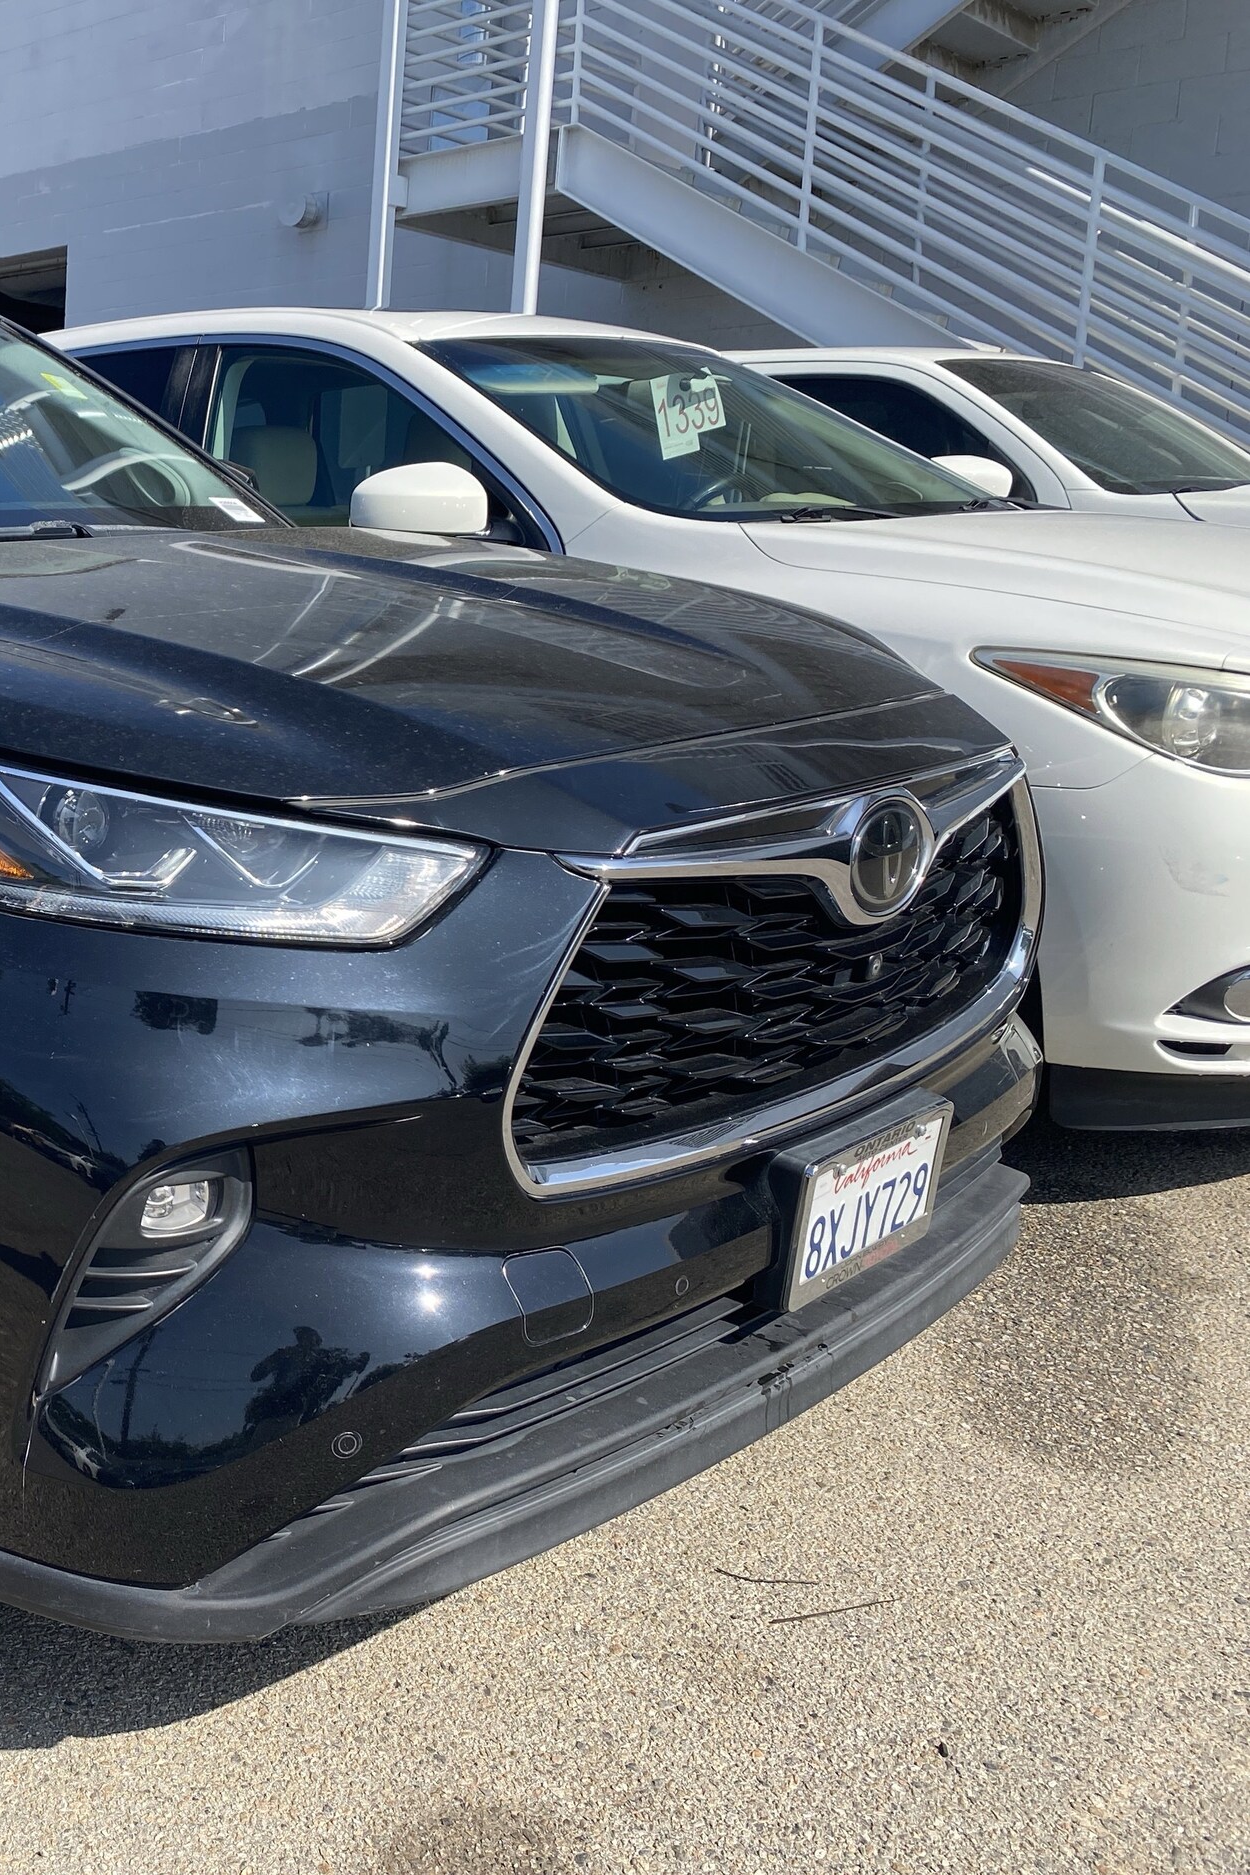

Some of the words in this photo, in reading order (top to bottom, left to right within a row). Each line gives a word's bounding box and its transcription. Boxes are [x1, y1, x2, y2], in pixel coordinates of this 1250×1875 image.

[658, 387, 719, 437] 1339
[854, 1121, 916, 1157] ONTARIO
[835, 1142, 918, 1194] California
[805, 1162, 928, 1279] 8XJY729
[826, 1262, 862, 1289] CROWN
